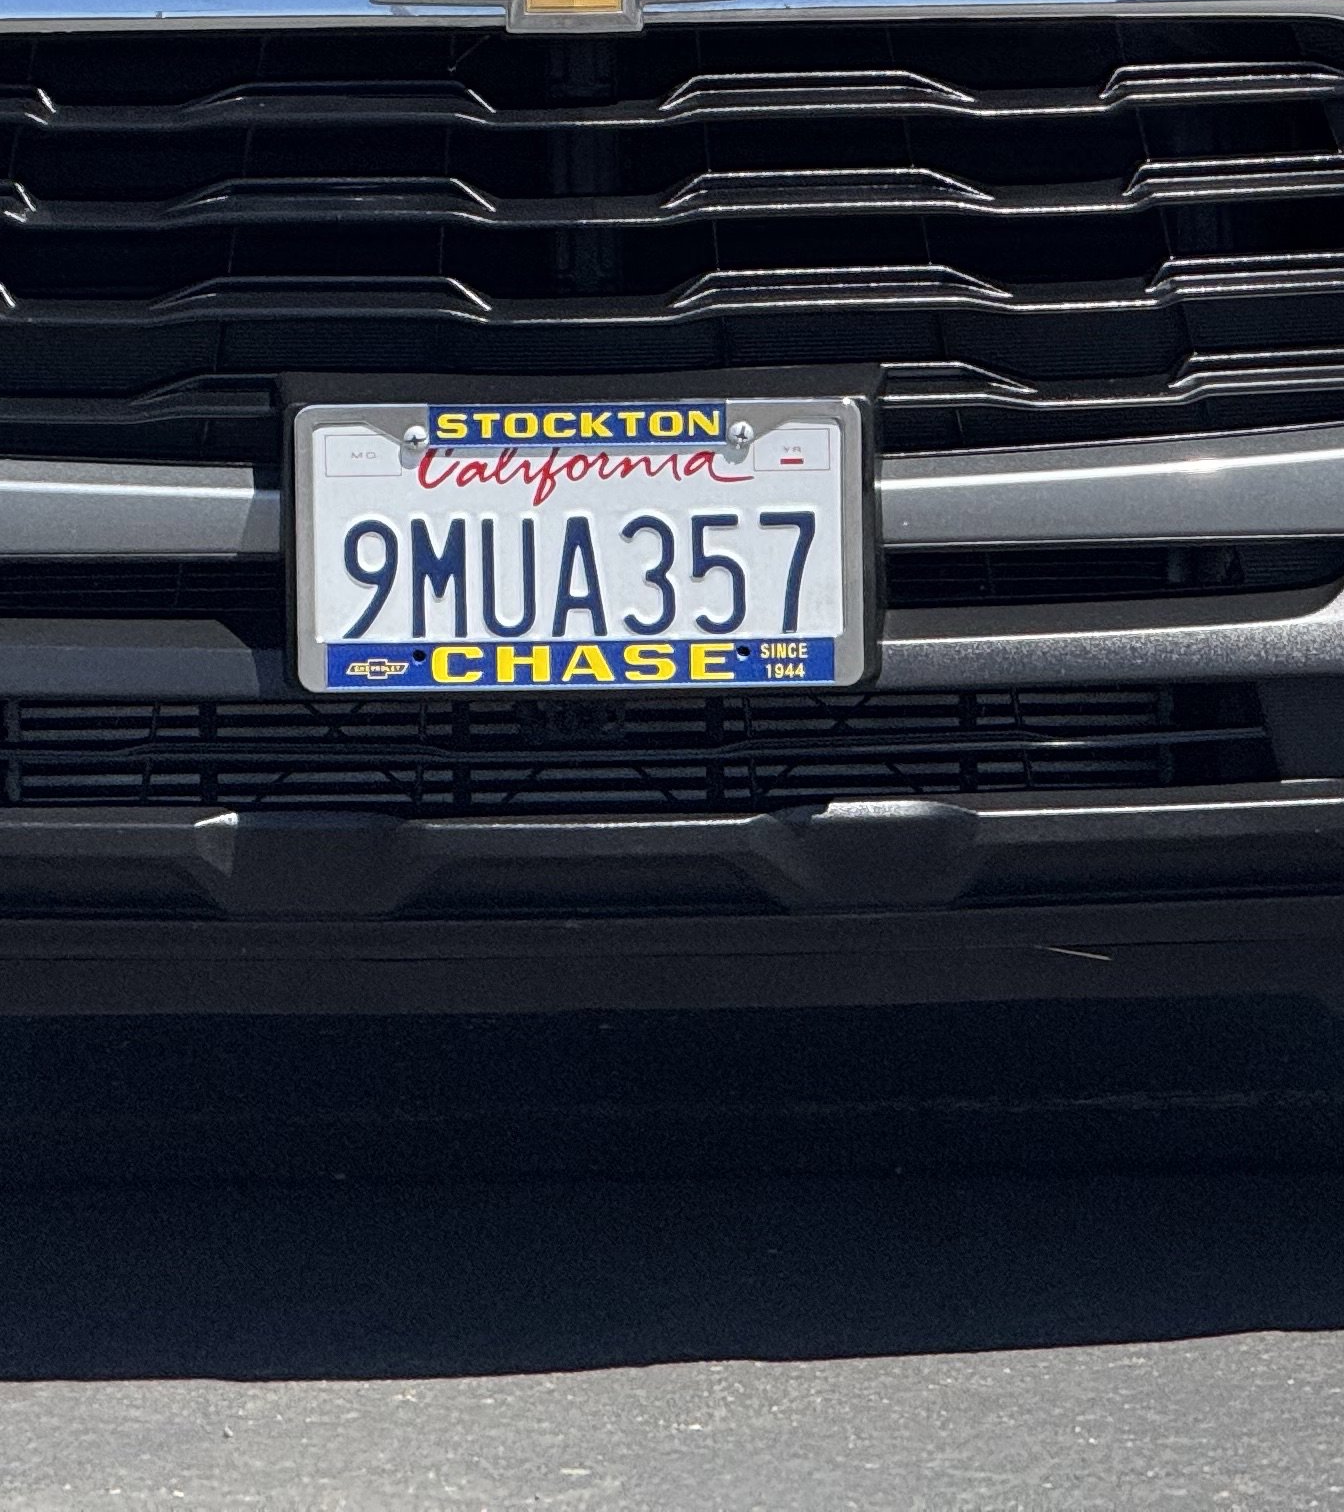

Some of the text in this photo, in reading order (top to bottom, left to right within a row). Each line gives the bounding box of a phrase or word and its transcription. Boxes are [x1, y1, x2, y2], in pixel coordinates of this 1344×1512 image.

[436, 410, 720, 439] STOCKTON
[417, 447, 754, 506] California
[343, 511, 816, 639] 9MUA357
[431, 643, 736, 684] CHASE
[760, 642, 808, 659] SINCE
[765, 662, 805, 679] 1944
